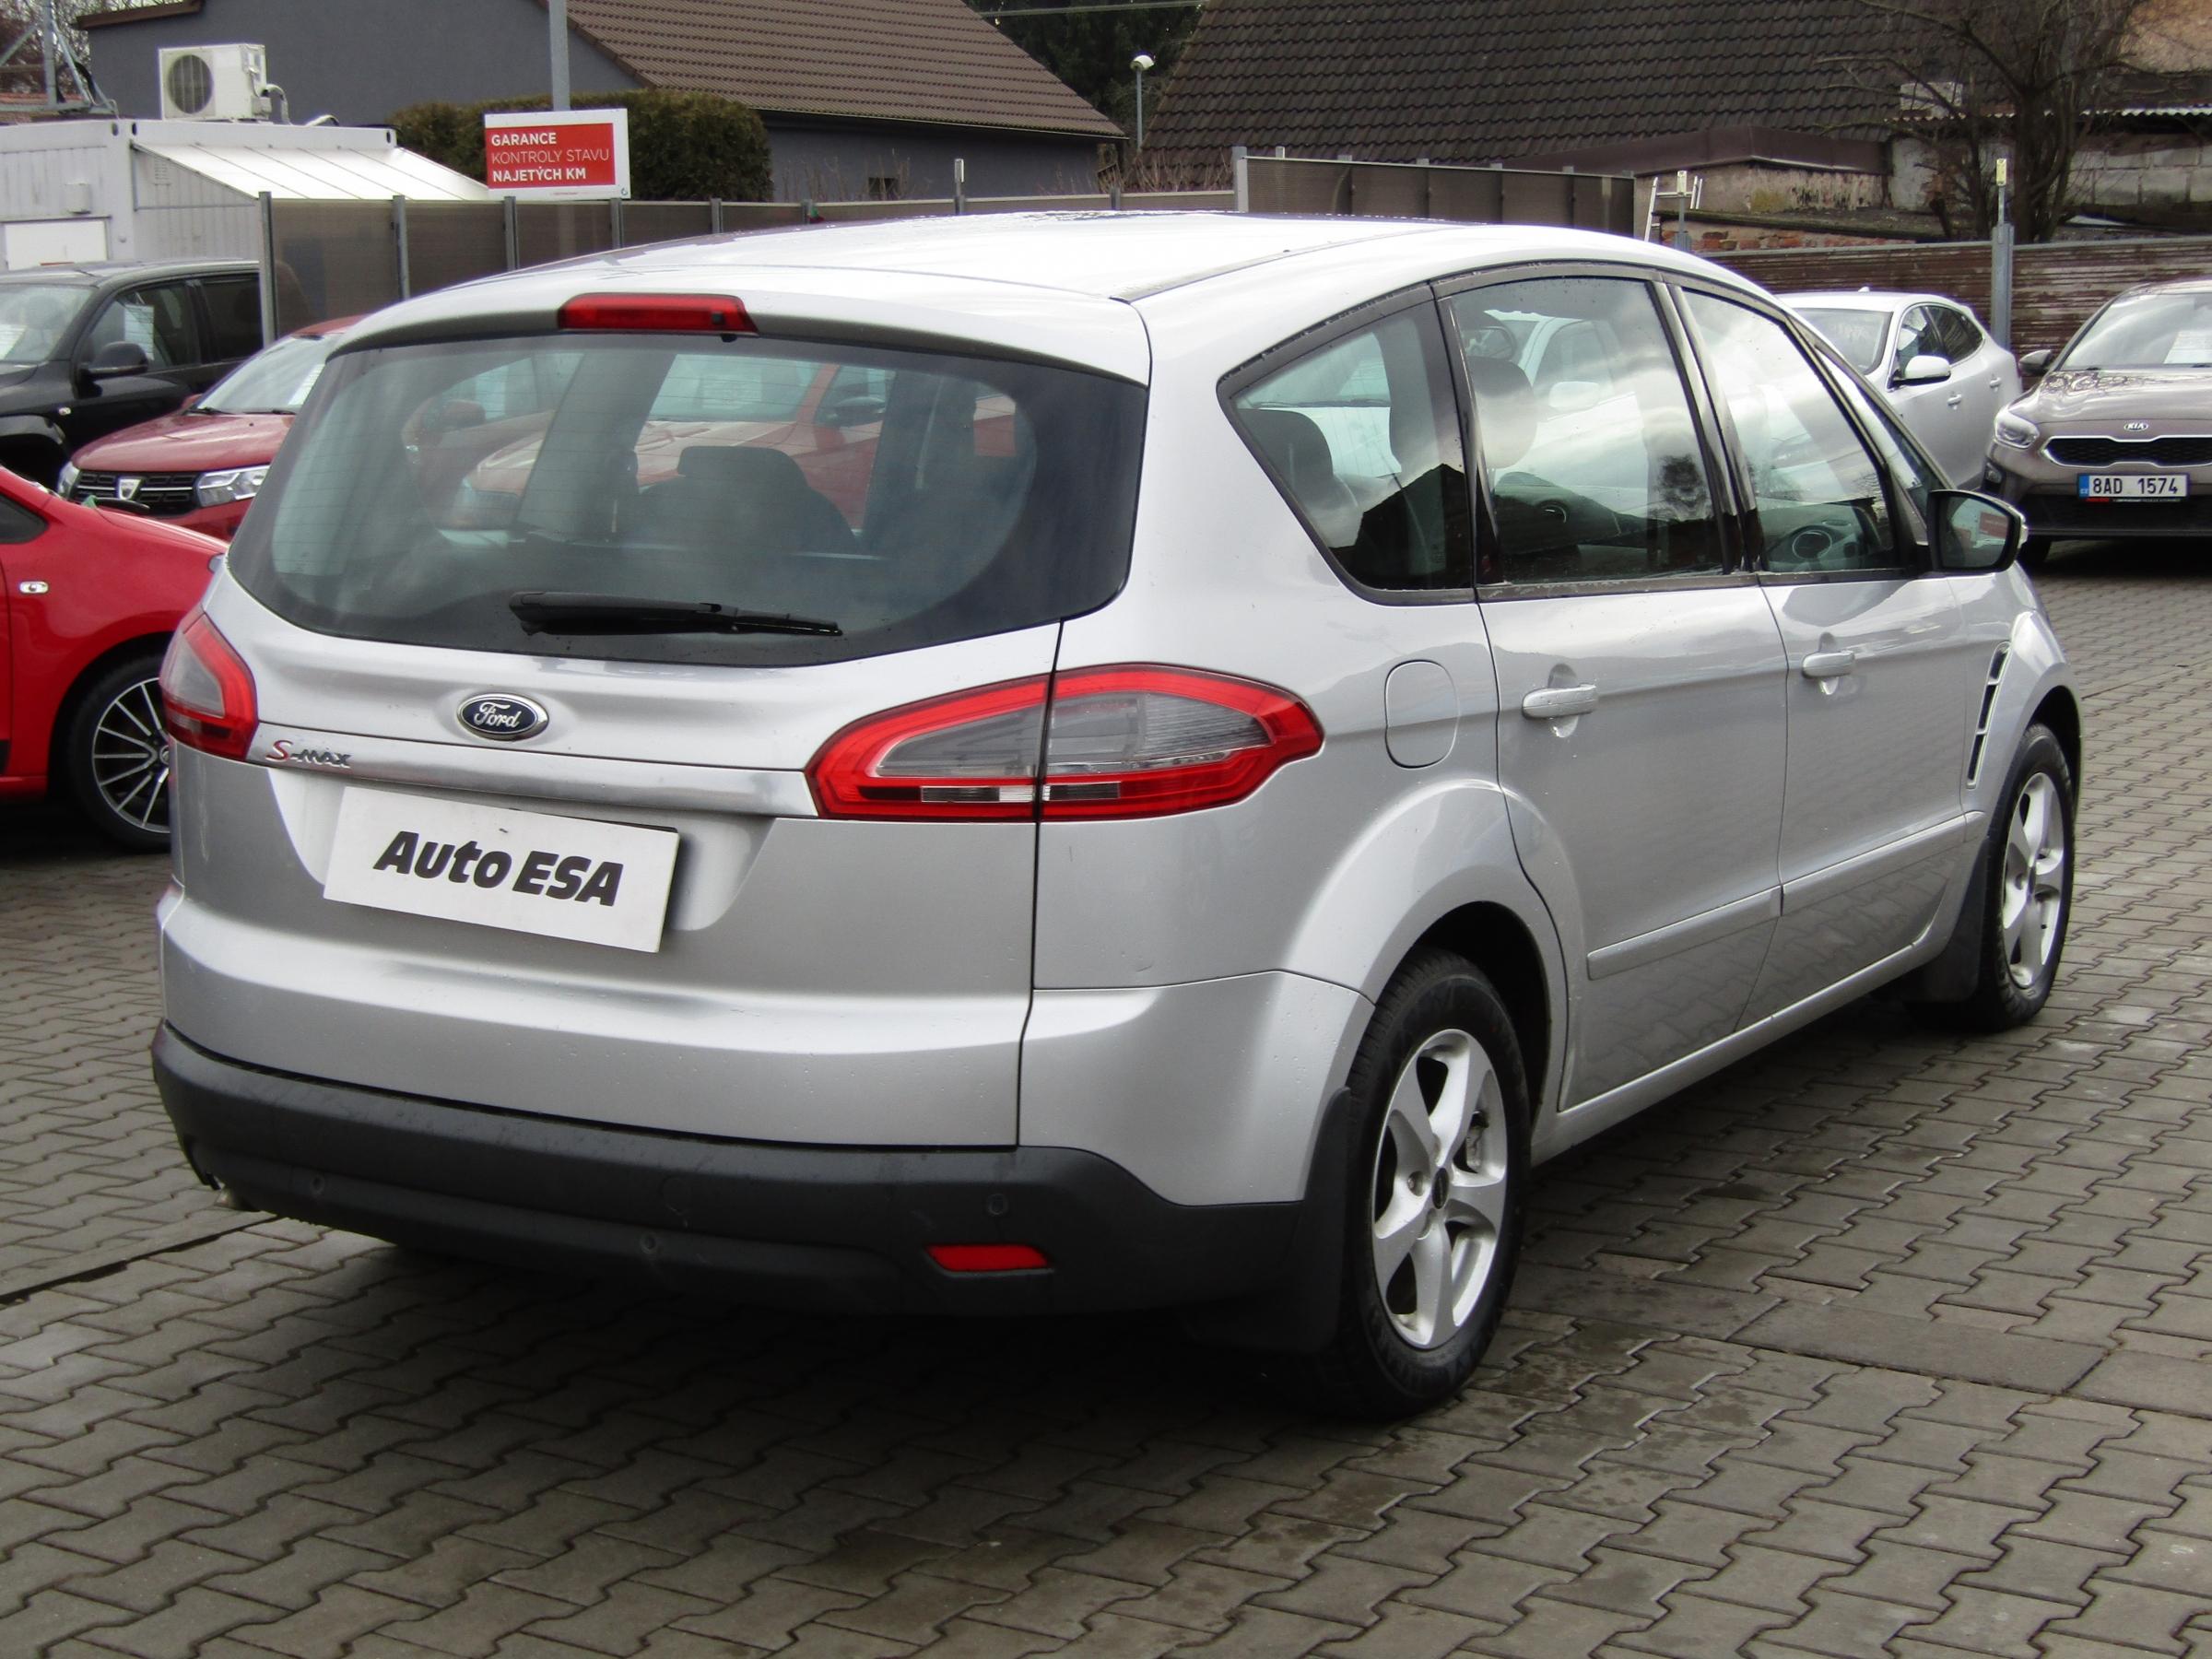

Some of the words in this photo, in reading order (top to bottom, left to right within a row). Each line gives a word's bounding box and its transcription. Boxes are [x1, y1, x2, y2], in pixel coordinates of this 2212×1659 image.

[491, 133, 557, 147] GARANCE
[491, 150, 562, 164] KONTROLY
[566, 148, 609, 162] STAVU
[493, 166, 562, 182] NAJETÝCH
[566, 168, 586, 180] KM
[2126, 422, 2145, 430] KIA
[2093, 477, 2123, 494] 8AD
[2137, 477, 2178, 494] 1574
[473, 701, 521, 730] Ford
[373, 830, 512, 888] Auto
[512, 851, 623, 906] ESA
